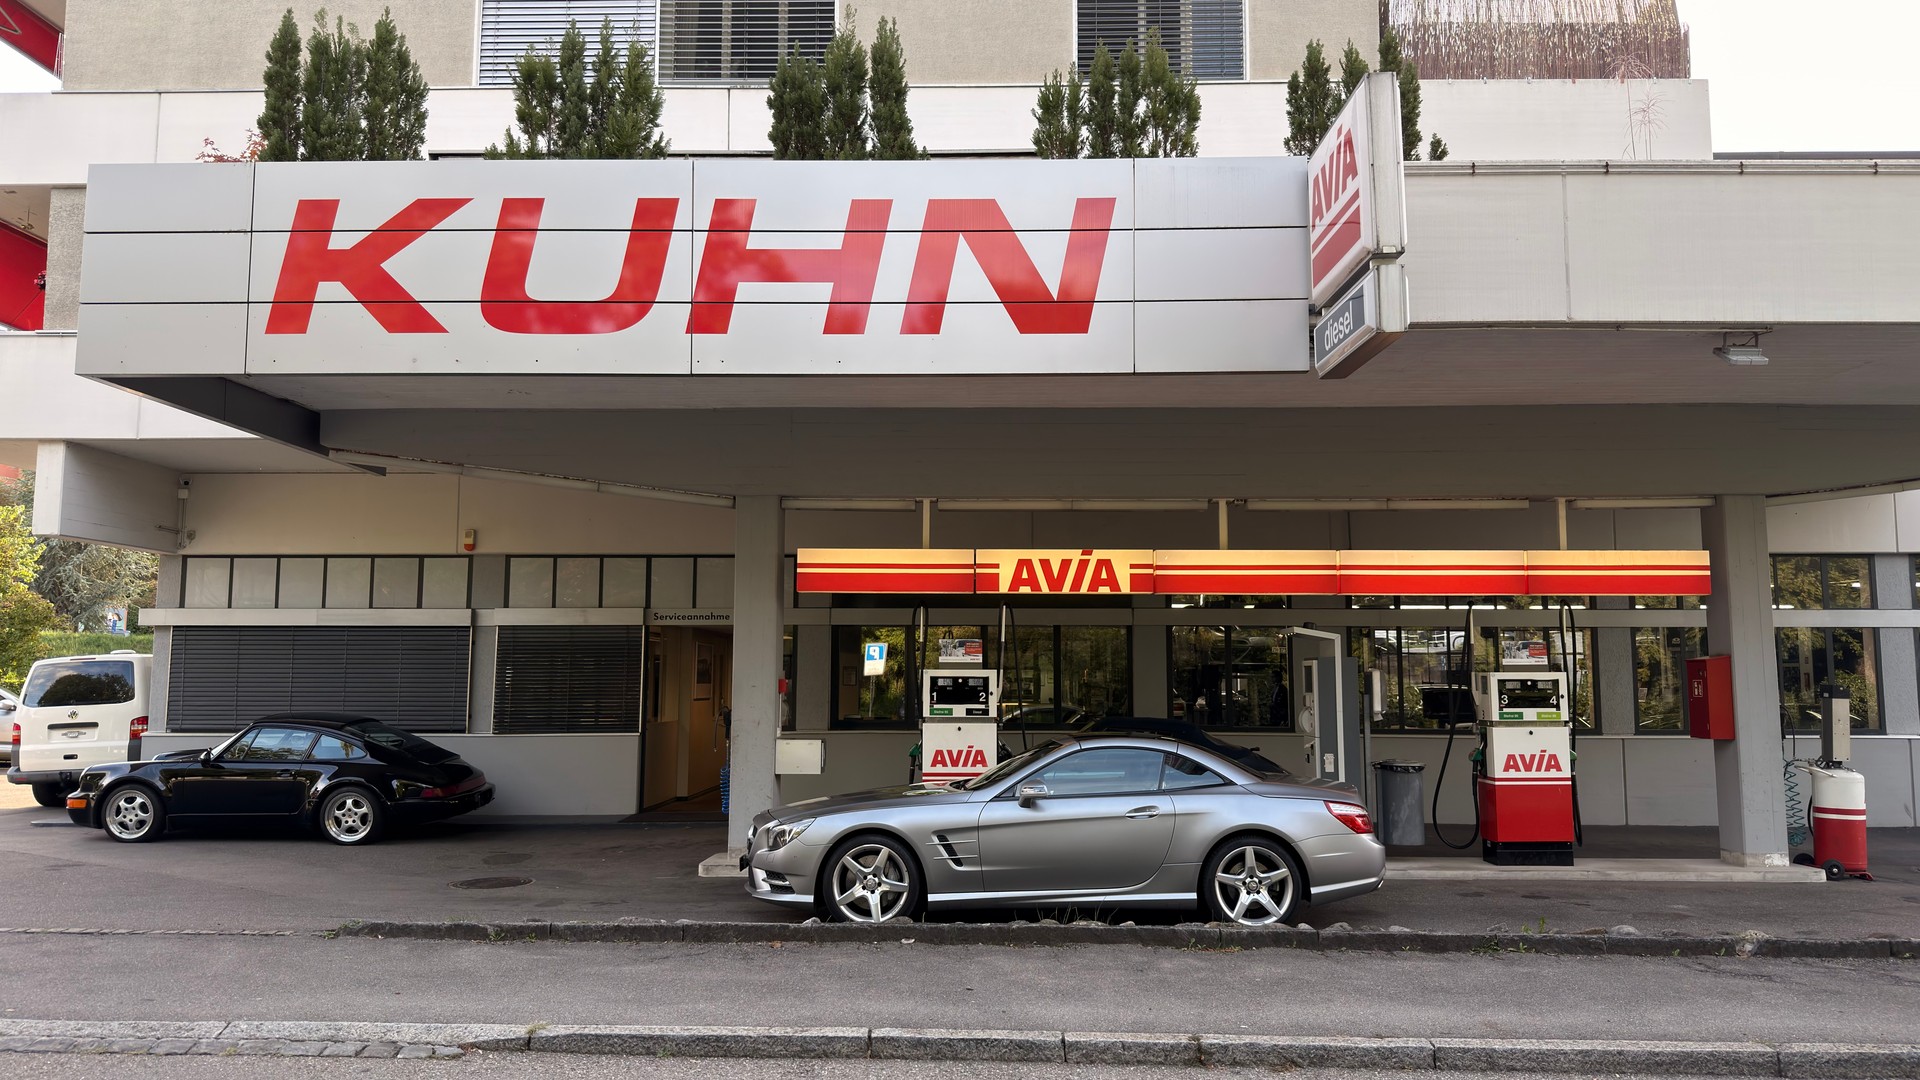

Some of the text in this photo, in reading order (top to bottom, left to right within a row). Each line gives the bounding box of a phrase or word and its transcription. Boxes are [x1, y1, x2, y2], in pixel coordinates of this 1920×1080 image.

[265, 198, 1116, 334] KUHN
[1324, 300, 1353, 351] diesel
[653, 612, 731, 621] Serviceannahme
[931, 691, 937, 701] 1
[979, 692, 986, 701] 2
[1501, 695, 1508, 704] 3
[1549, 696, 1557, 705] 4
